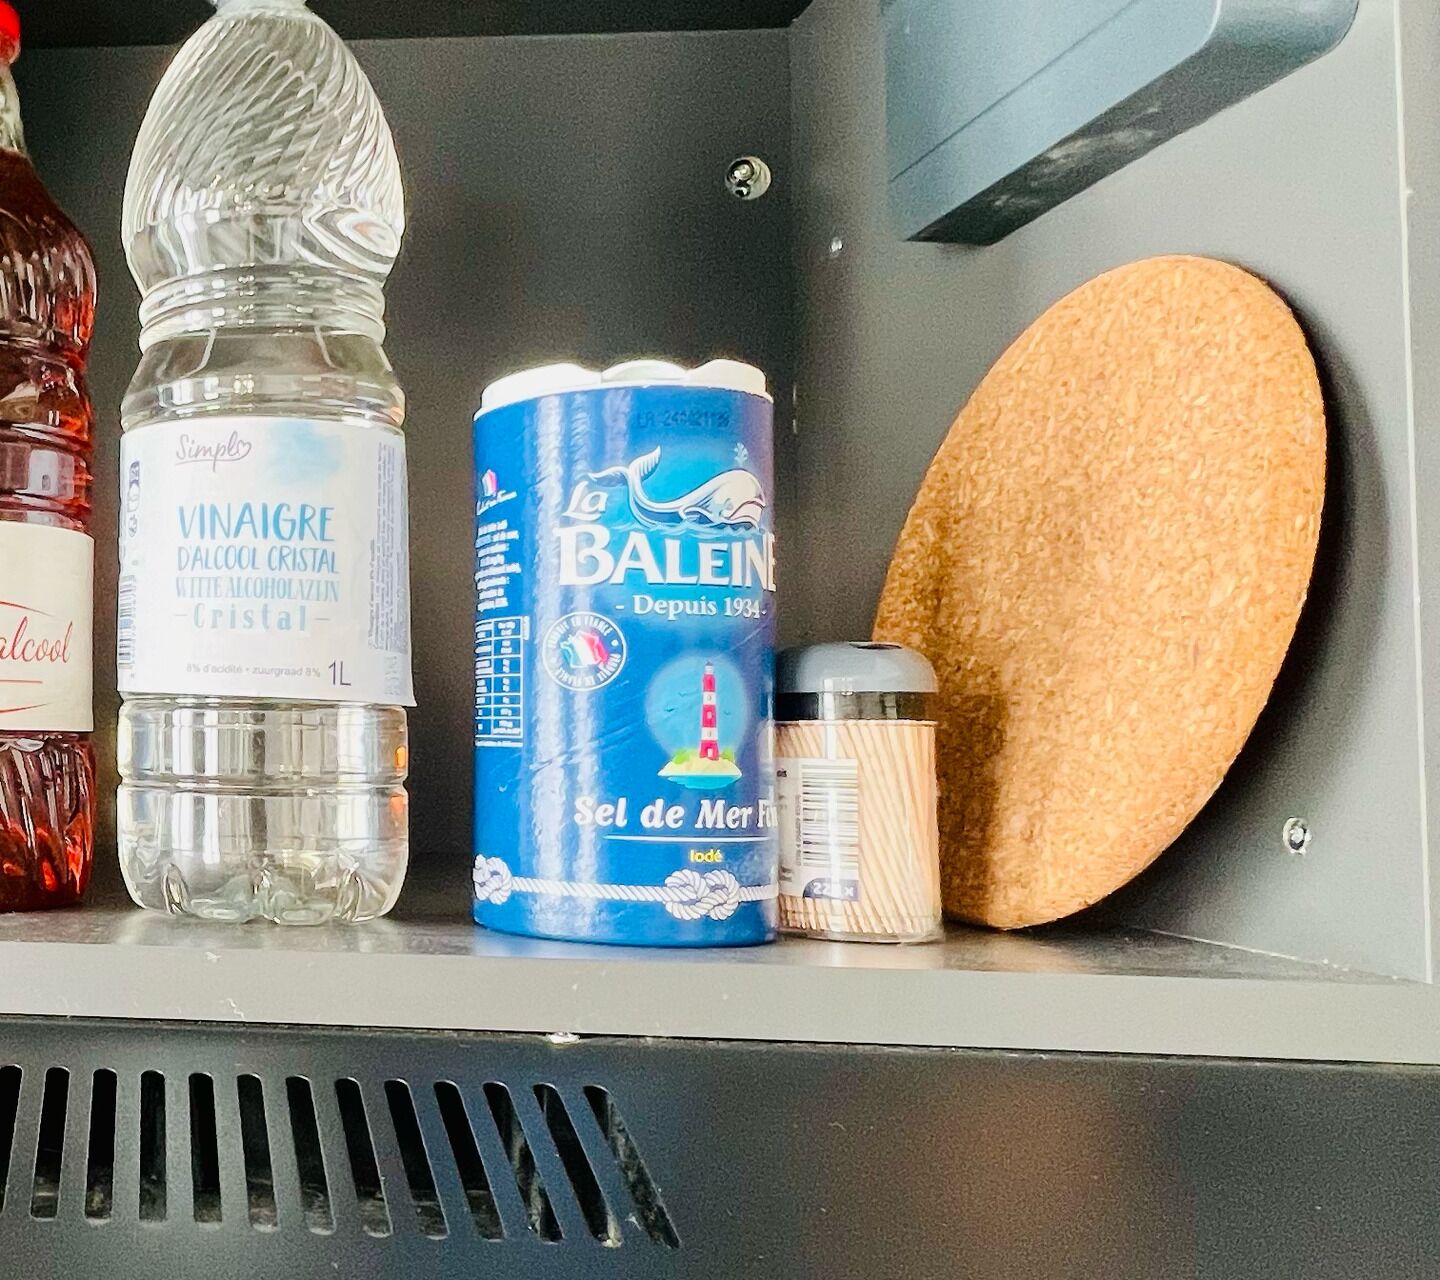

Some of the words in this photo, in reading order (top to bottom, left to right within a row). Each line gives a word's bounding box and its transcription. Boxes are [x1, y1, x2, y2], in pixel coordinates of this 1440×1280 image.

[561, 481, 608, 521] La
[179, 502, 335, 542] VINAIGRE
[177, 545, 260, 572] D'ALCOOL
[267, 546, 340, 574] CRISTAL
[175, 576, 222, 599] WITTE
[225, 577, 340, 602] ALCOHOLAZIJN
[192, 602, 308, 631] Cristal
[633, 595, 717, 619] Depuis
[724, 597, 760, 619] 1934
[327, 659, 352, 687] 1L
[573, 796, 629, 828] Sel
[640, 798, 685, 829] de
[695, 799, 753, 829] Mer
[689, 848, 724, 864] Iodé
